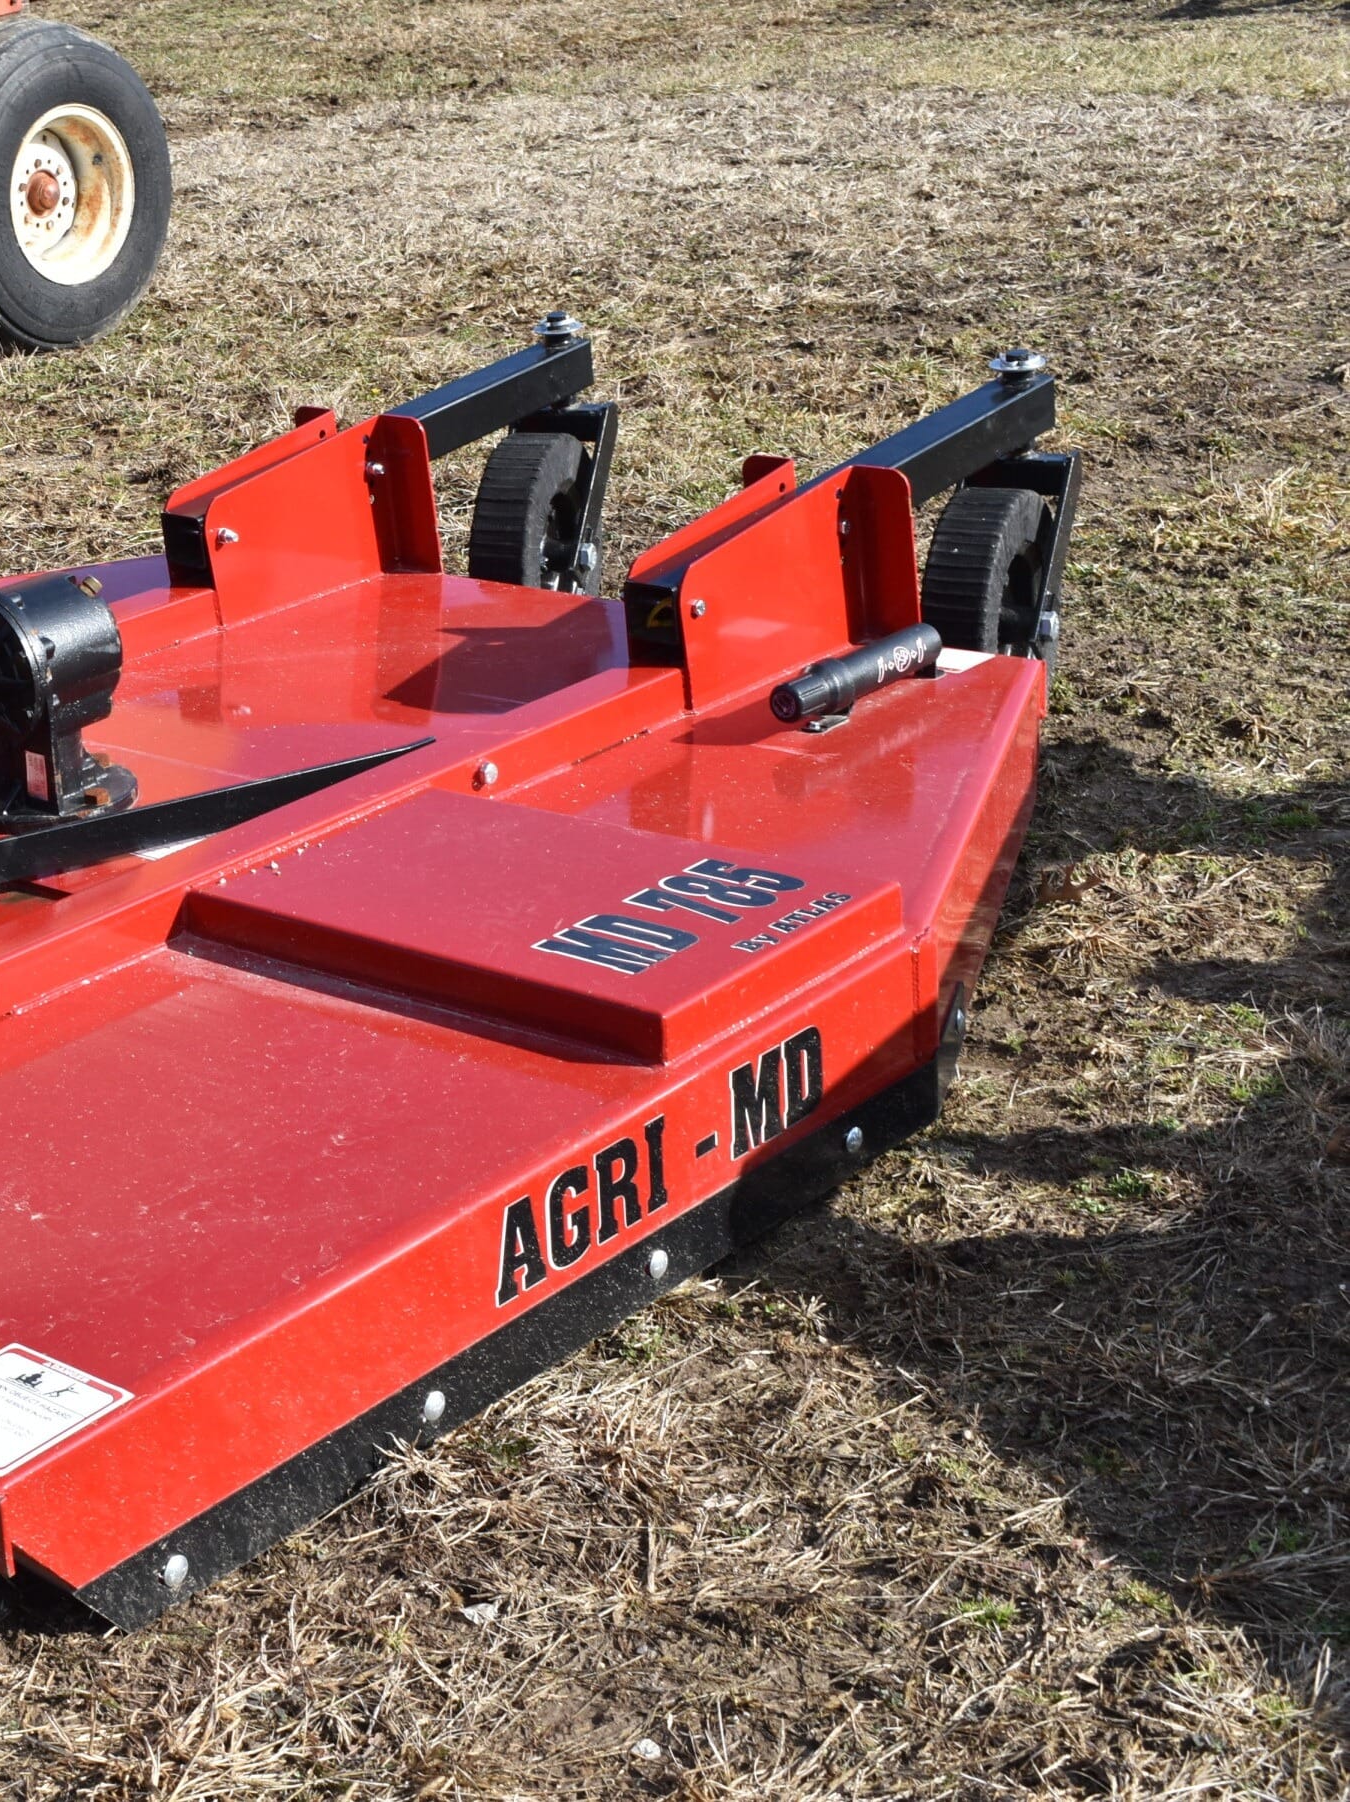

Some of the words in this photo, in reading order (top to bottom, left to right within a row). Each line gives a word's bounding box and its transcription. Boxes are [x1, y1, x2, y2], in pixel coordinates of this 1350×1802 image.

[530, 914, 700, 975] MD
[622, 858, 806, 925] 785
[768, 891, 852, 934] ATLAS
[494, 1113, 668, 1308] AGRI
[728, 1025, 824, 1162] MD
[8, 1389, 42, 1406] OBJECT
